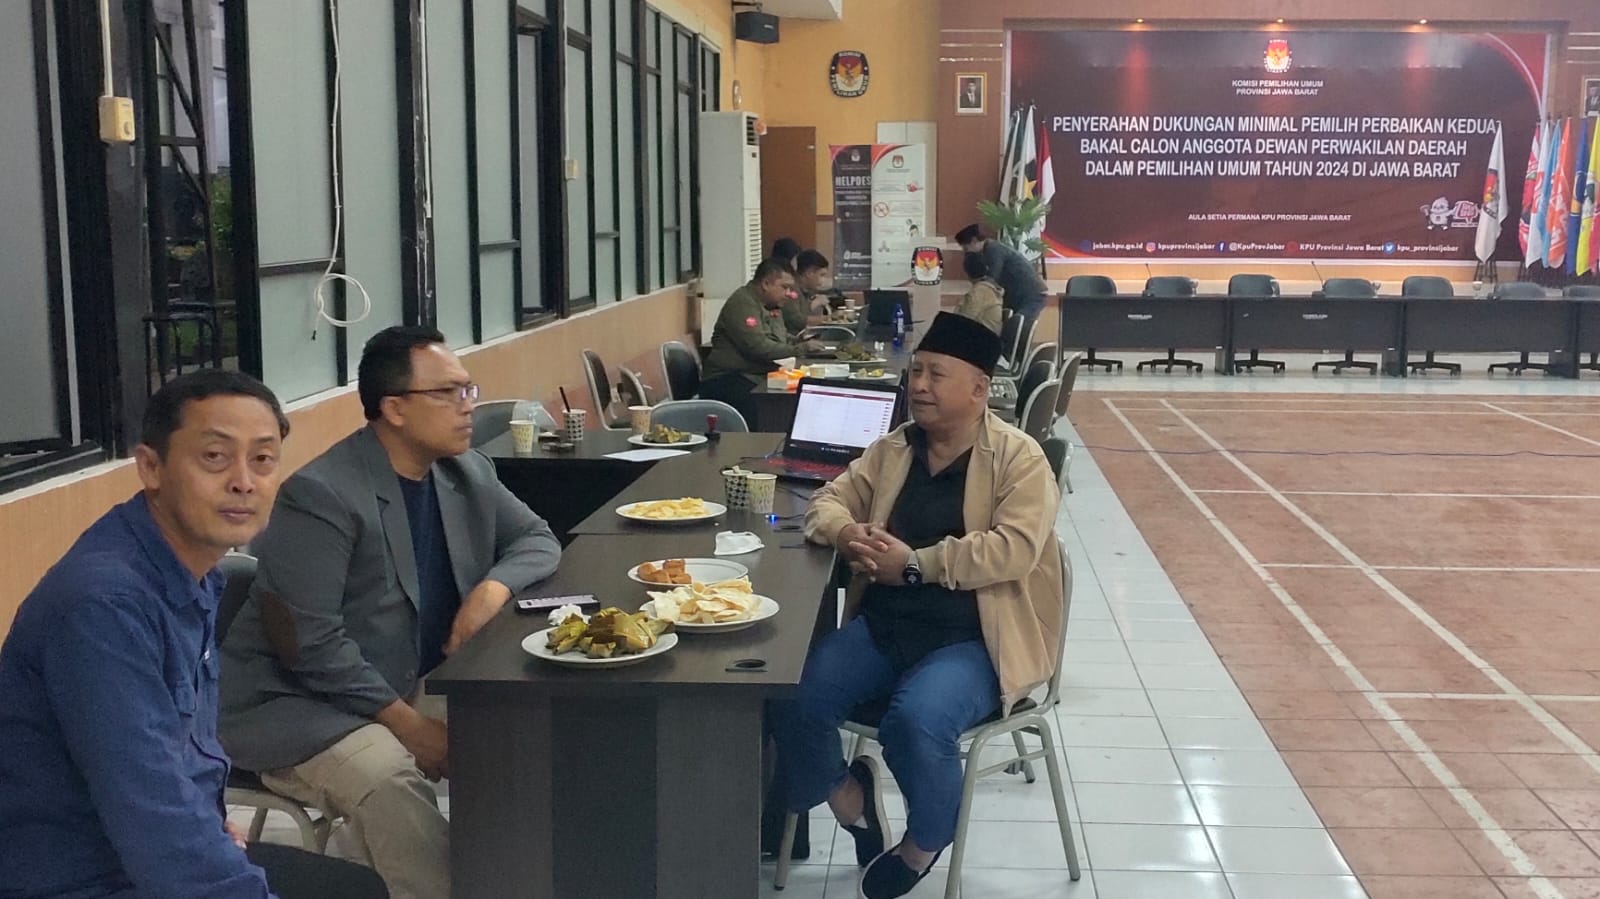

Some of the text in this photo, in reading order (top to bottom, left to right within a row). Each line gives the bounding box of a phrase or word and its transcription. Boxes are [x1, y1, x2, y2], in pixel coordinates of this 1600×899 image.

[1232, 79, 1324, 88] KOMISI PEMILIHAN UMUM
[1236, 88, 1319, 96] PROVINSI JAWA BARAT
[1053, 115, 1496, 135] PENYERAHAN DUKUNGAN MINIMAL PEMILIH PERBAIKAN KEDUA
[1080, 138, 1467, 157] BAKAL CALON ANGGOTA DEWAN PERWAKILAN DAERAH
[1085, 160, 1461, 179] DALAM PEMILIHAN UMUM TAHUN 2024 DI JAWA BARAT
[835, 176, 871, 186] HELPDES
[1188, 213, 1207, 221] AULA
[1207, 213, 1227, 221] SETIA
[1261, 213, 1276, 221] KPU
[1277, 213, 1308, 221] PROVINSI
[1309, 213, 1328, 221] JAWA
[1329, 213, 1352, 221] BARAT
[1299, 243, 1315, 251] KPU
[1317, 243, 1344, 251] Provinsi
